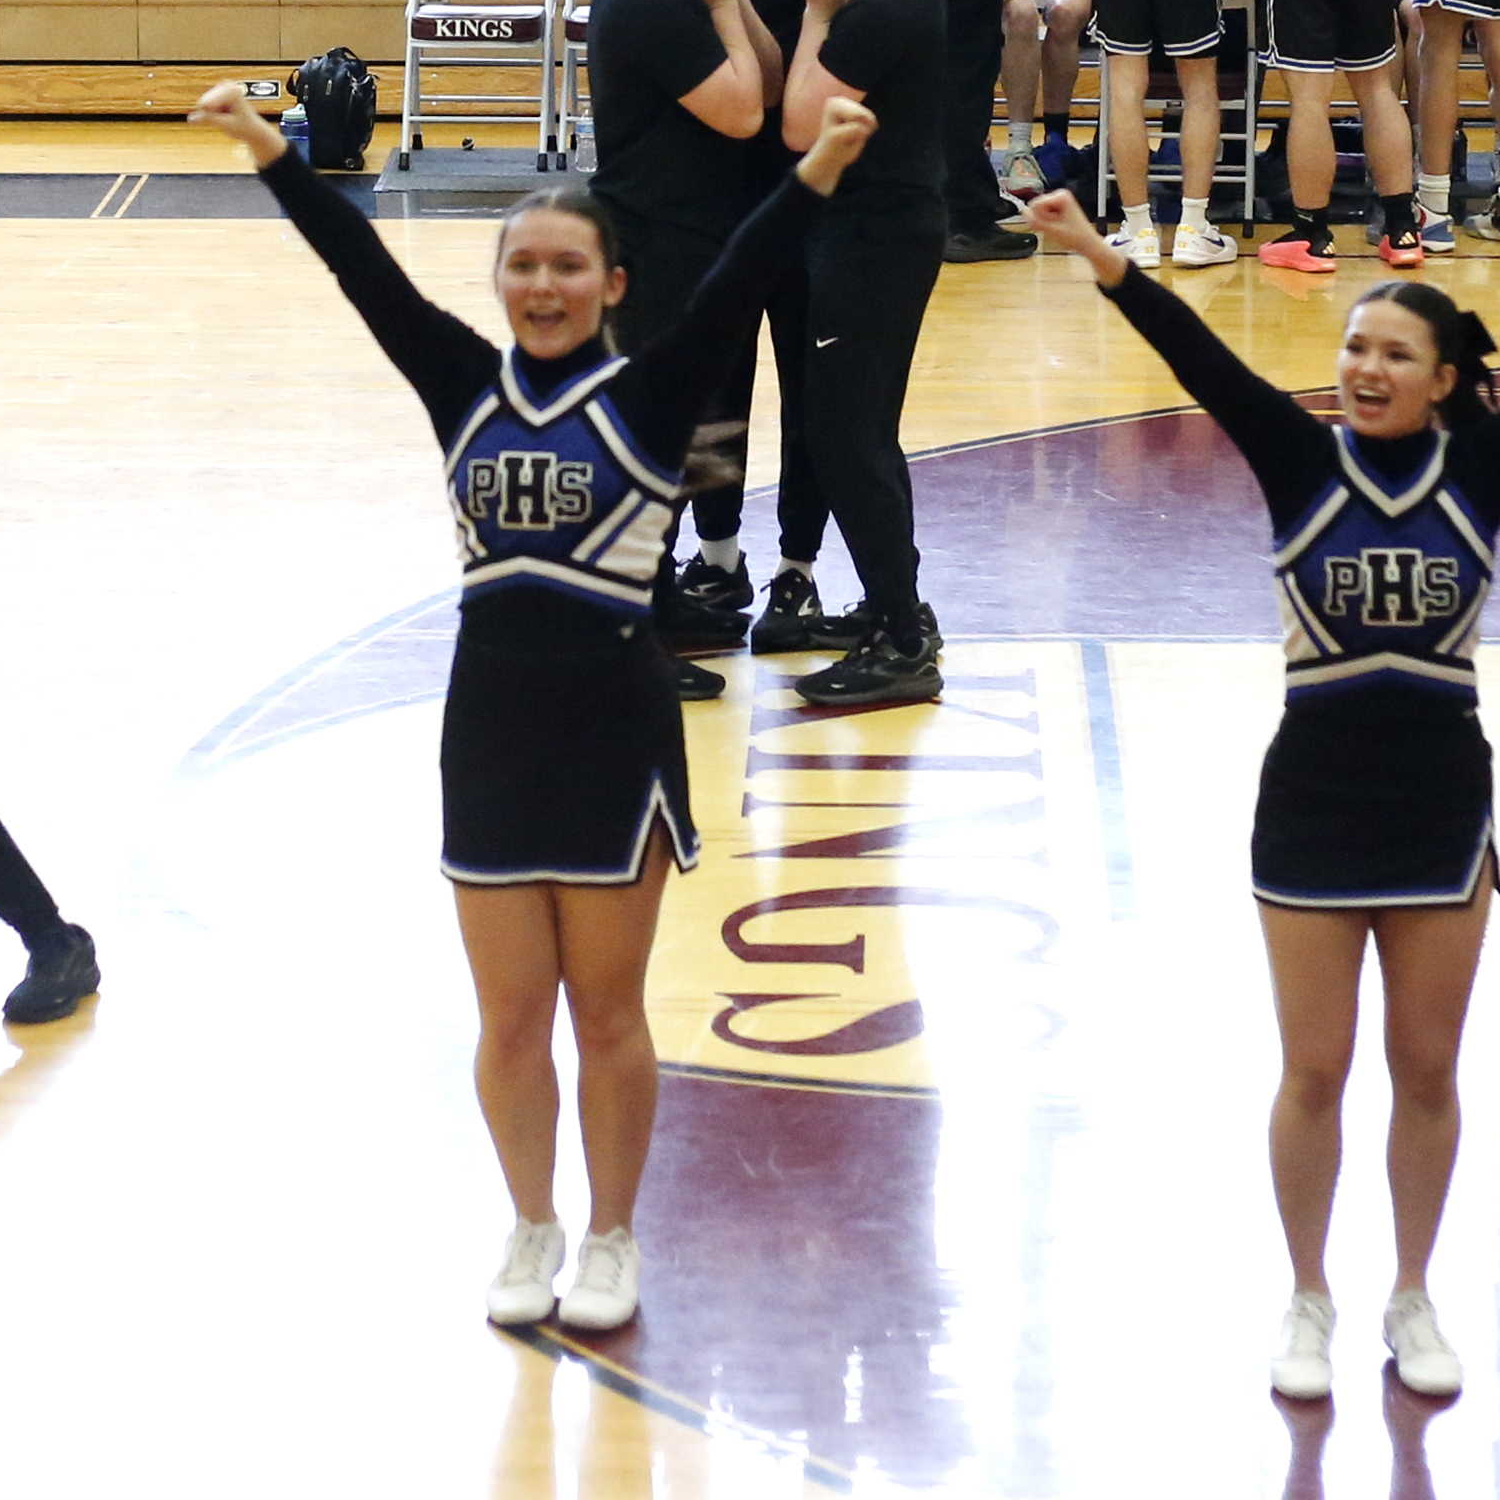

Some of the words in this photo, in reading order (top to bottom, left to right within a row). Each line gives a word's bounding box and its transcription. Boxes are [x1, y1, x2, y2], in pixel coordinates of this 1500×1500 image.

[434, 18, 514, 39] KINGS
[466, 449, 595, 532] PHS
[1322, 546, 1461, 627] PHS
